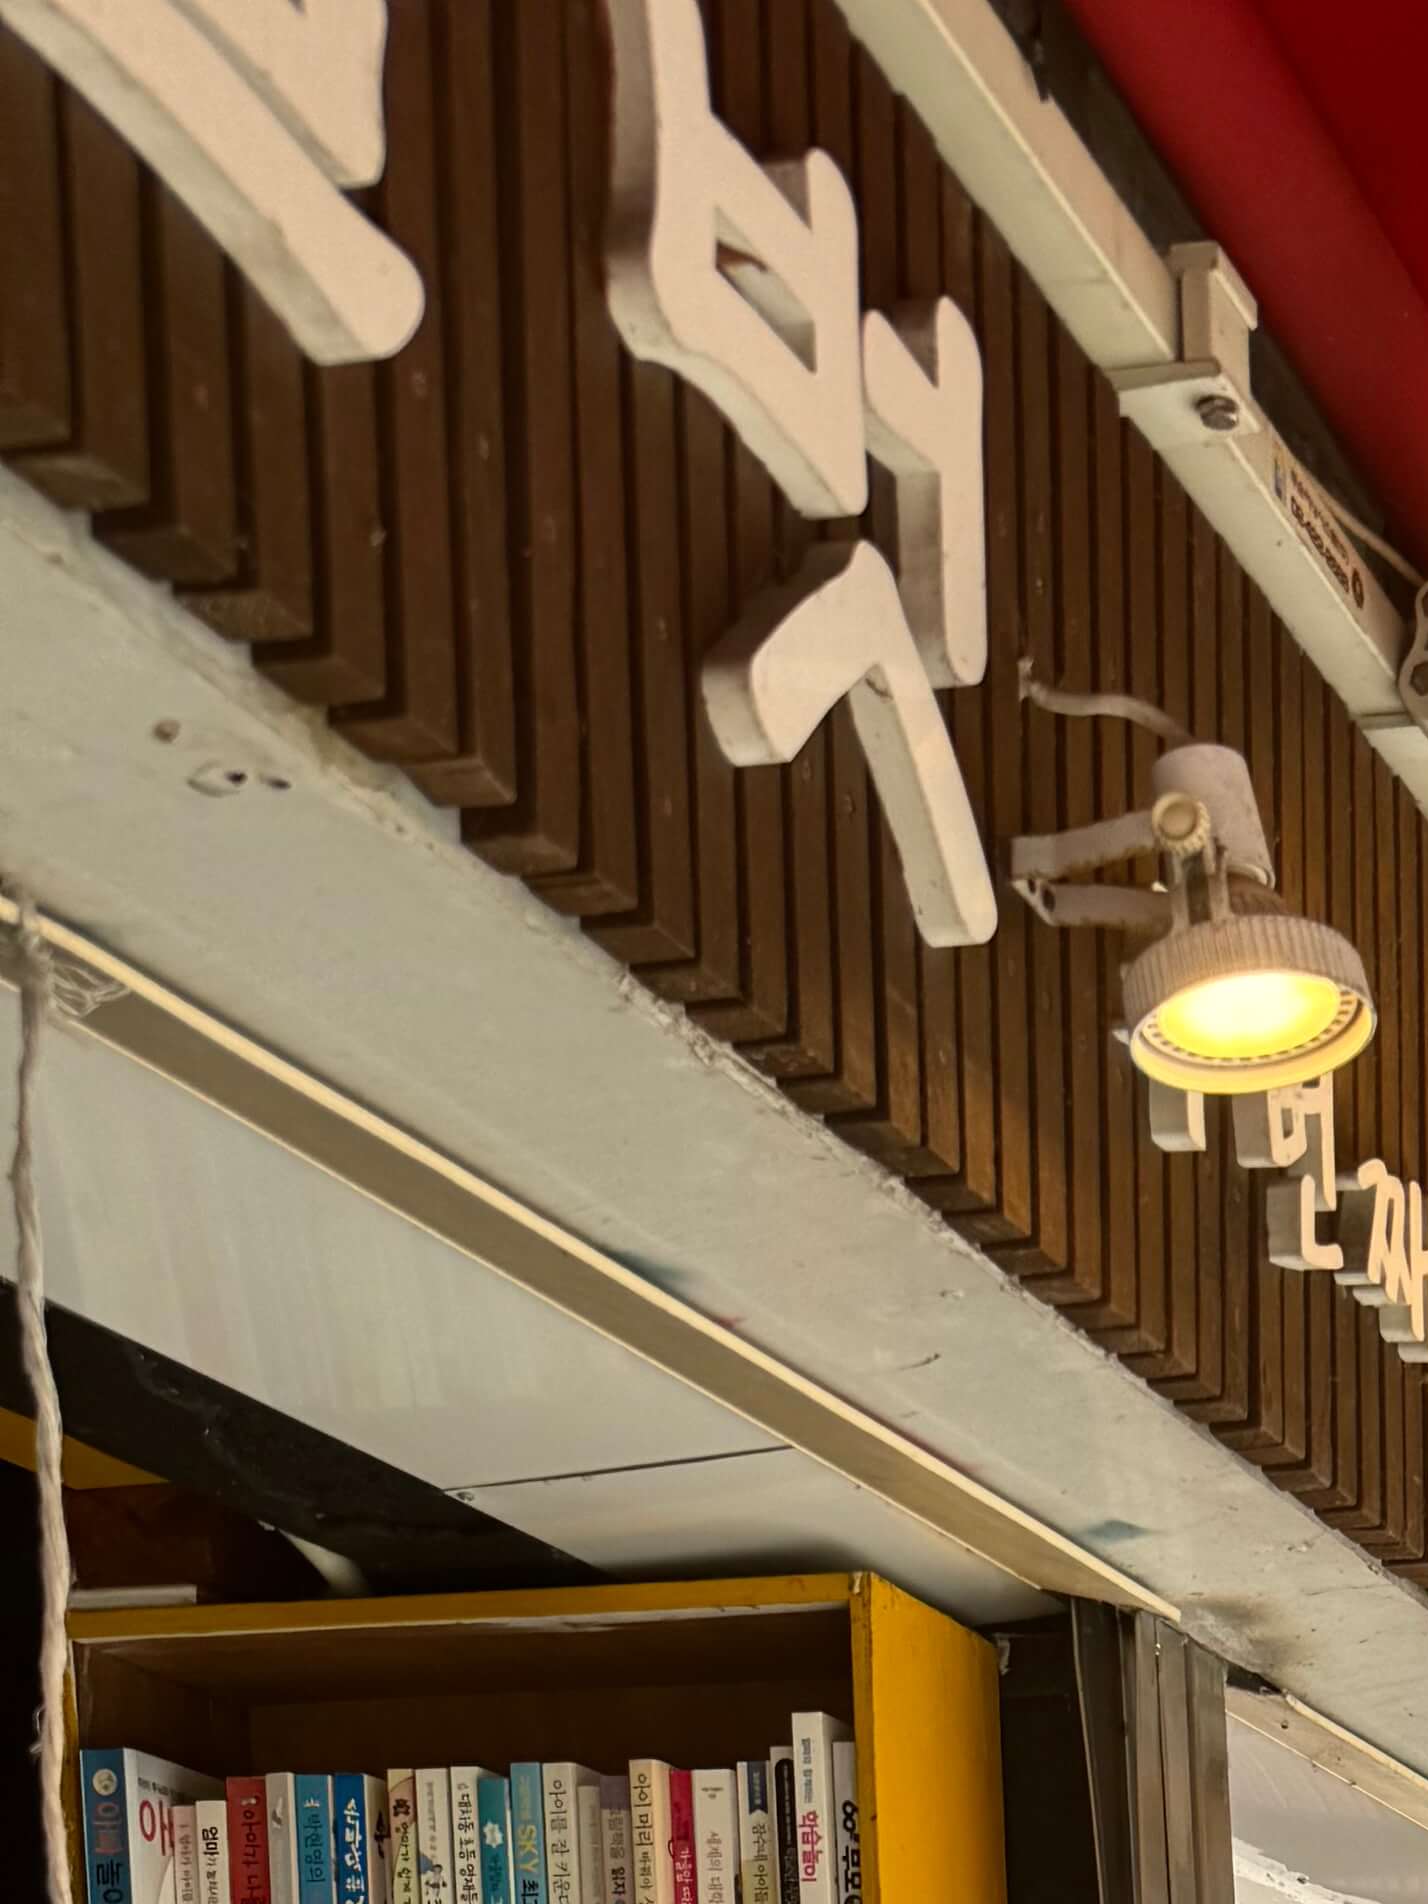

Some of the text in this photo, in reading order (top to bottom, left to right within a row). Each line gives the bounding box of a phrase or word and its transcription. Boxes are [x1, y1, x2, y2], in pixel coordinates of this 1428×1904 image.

[633, 1773, 653, 1809] 아이
[457, 1836, 475, 1861] 초등
[516, 1823, 539, 1874] SKY
[636, 1812, 658, 1847] 머리
[800, 1809, 823, 1883] 학습놀이
[706, 1830, 724, 1872] 세계의
[843, 1844, 862, 1894] 부모
[610, 1866, 628, 1895] 읽자
